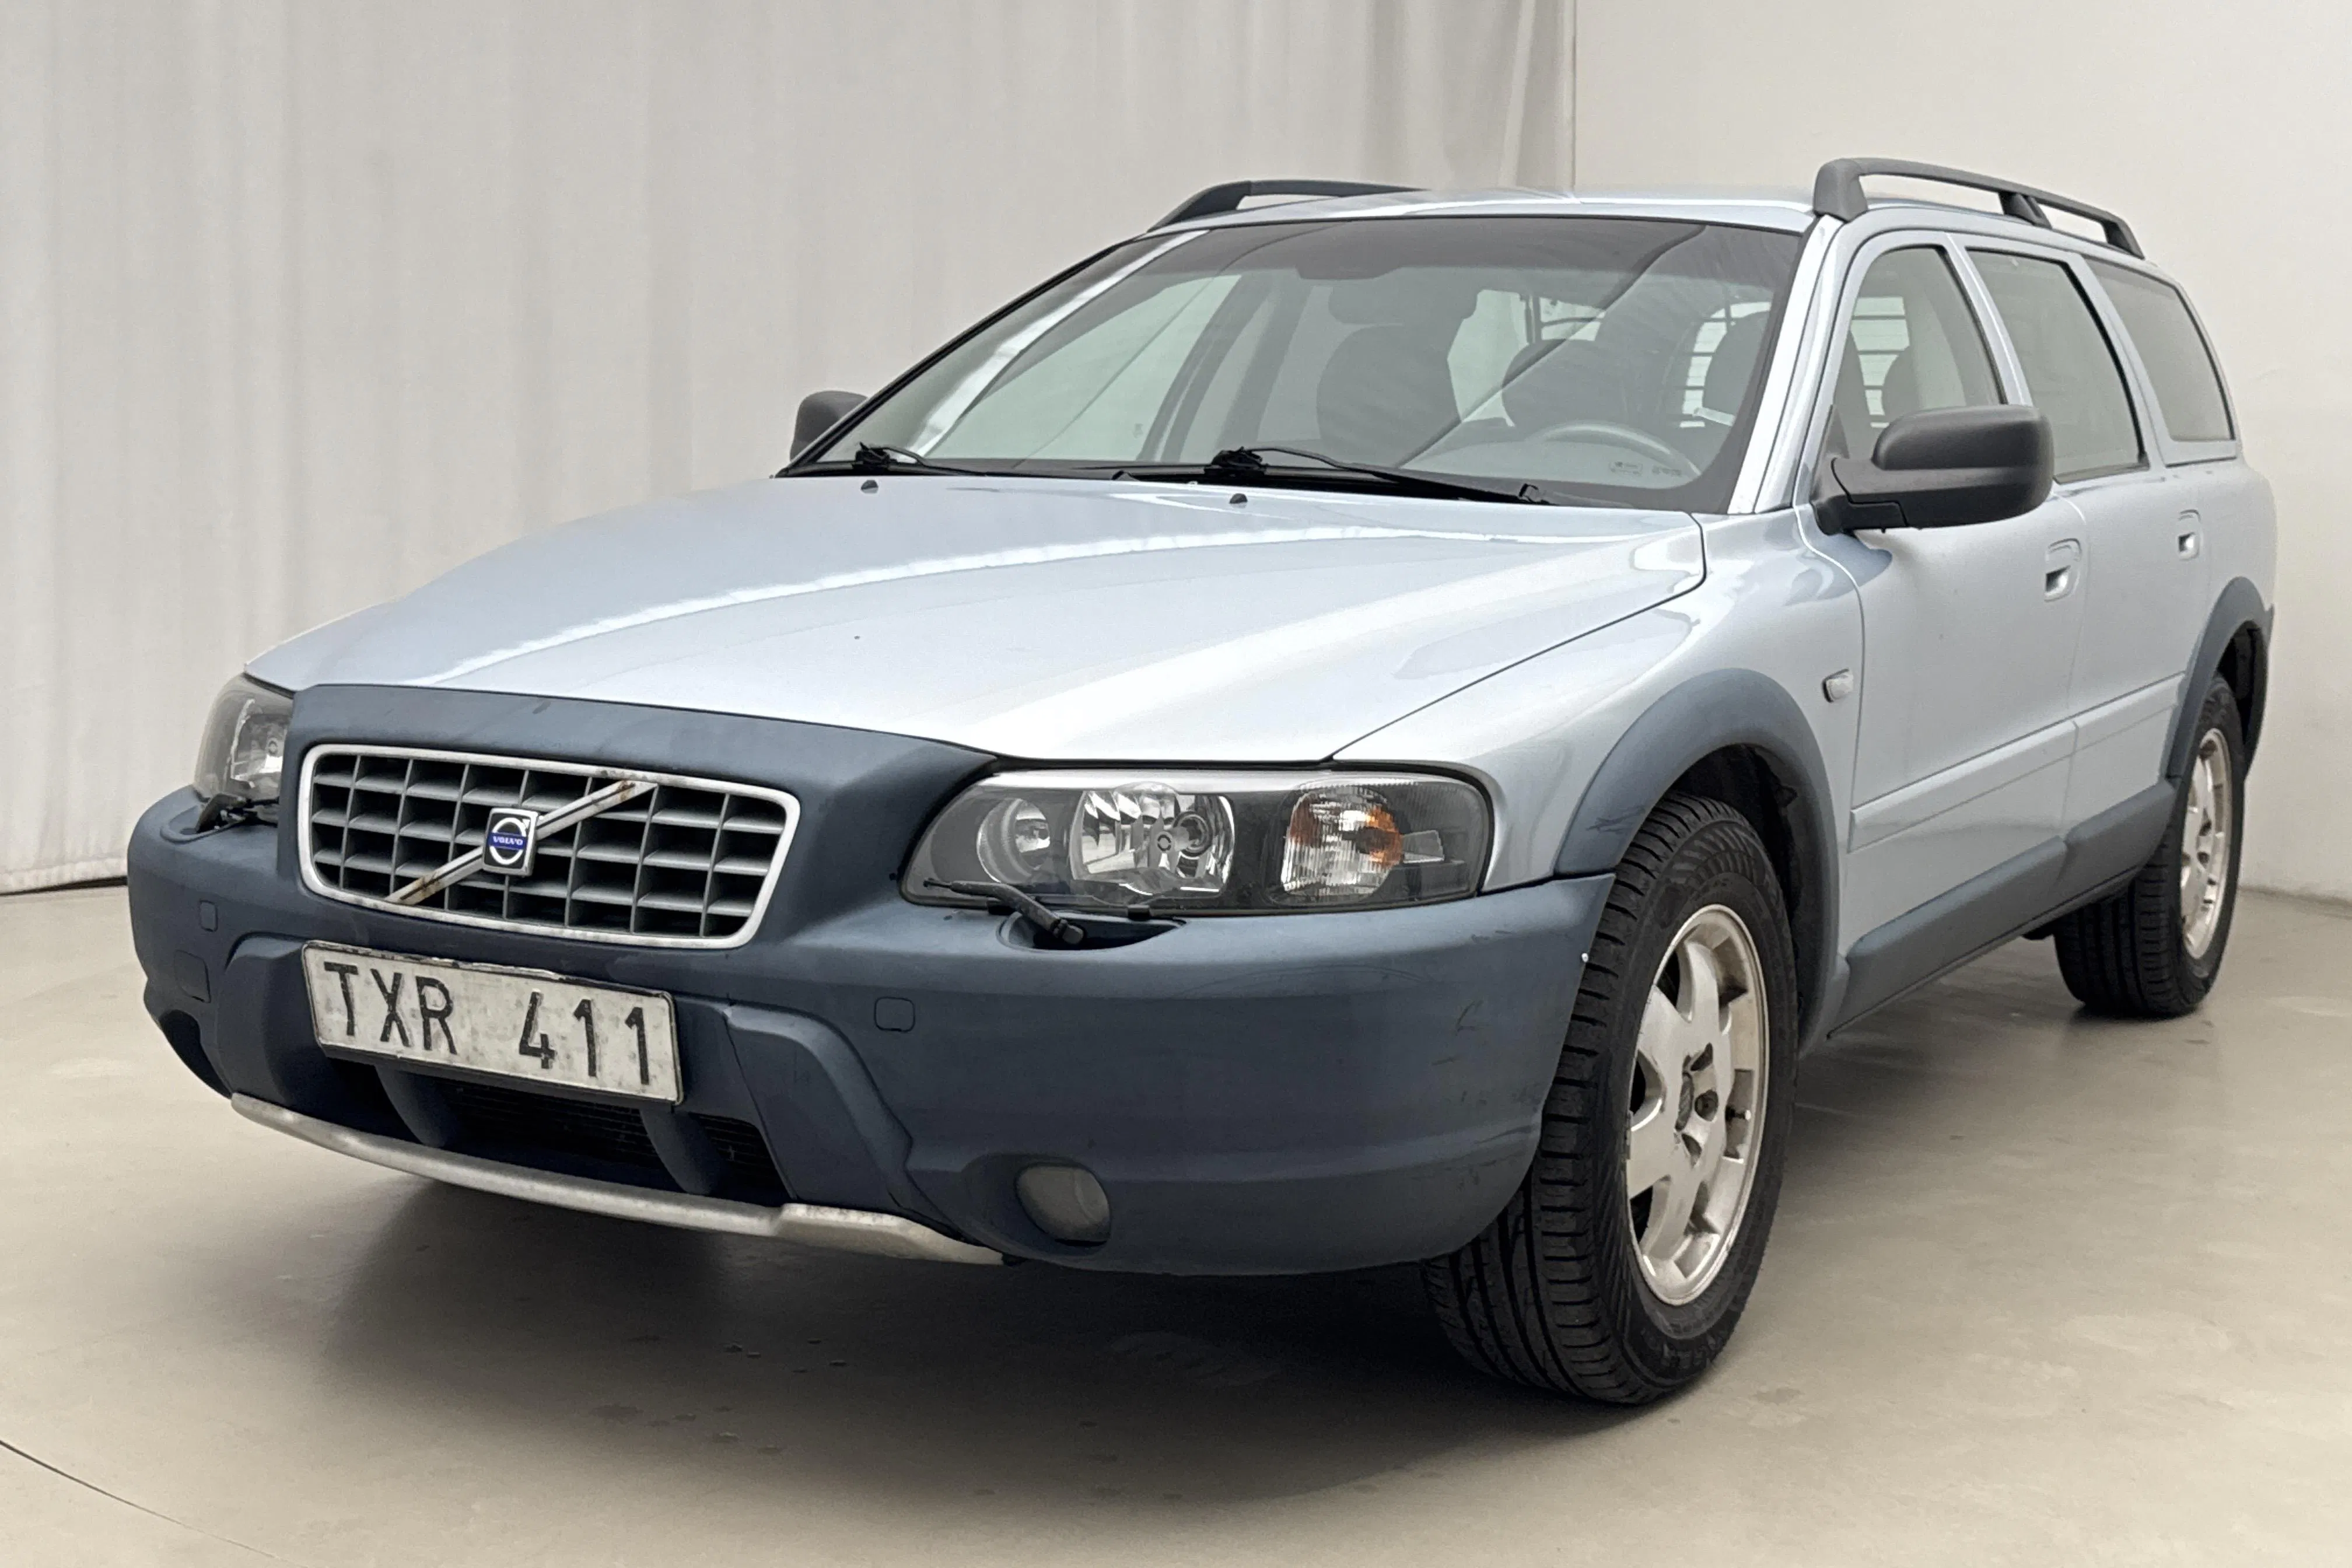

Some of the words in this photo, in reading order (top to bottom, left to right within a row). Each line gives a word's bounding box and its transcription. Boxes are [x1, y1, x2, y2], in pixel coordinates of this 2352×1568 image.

[493, 836, 523, 845] VOLVO
[324, 961, 457, 1055] TXR
[519, 991, 649, 1085] 411
